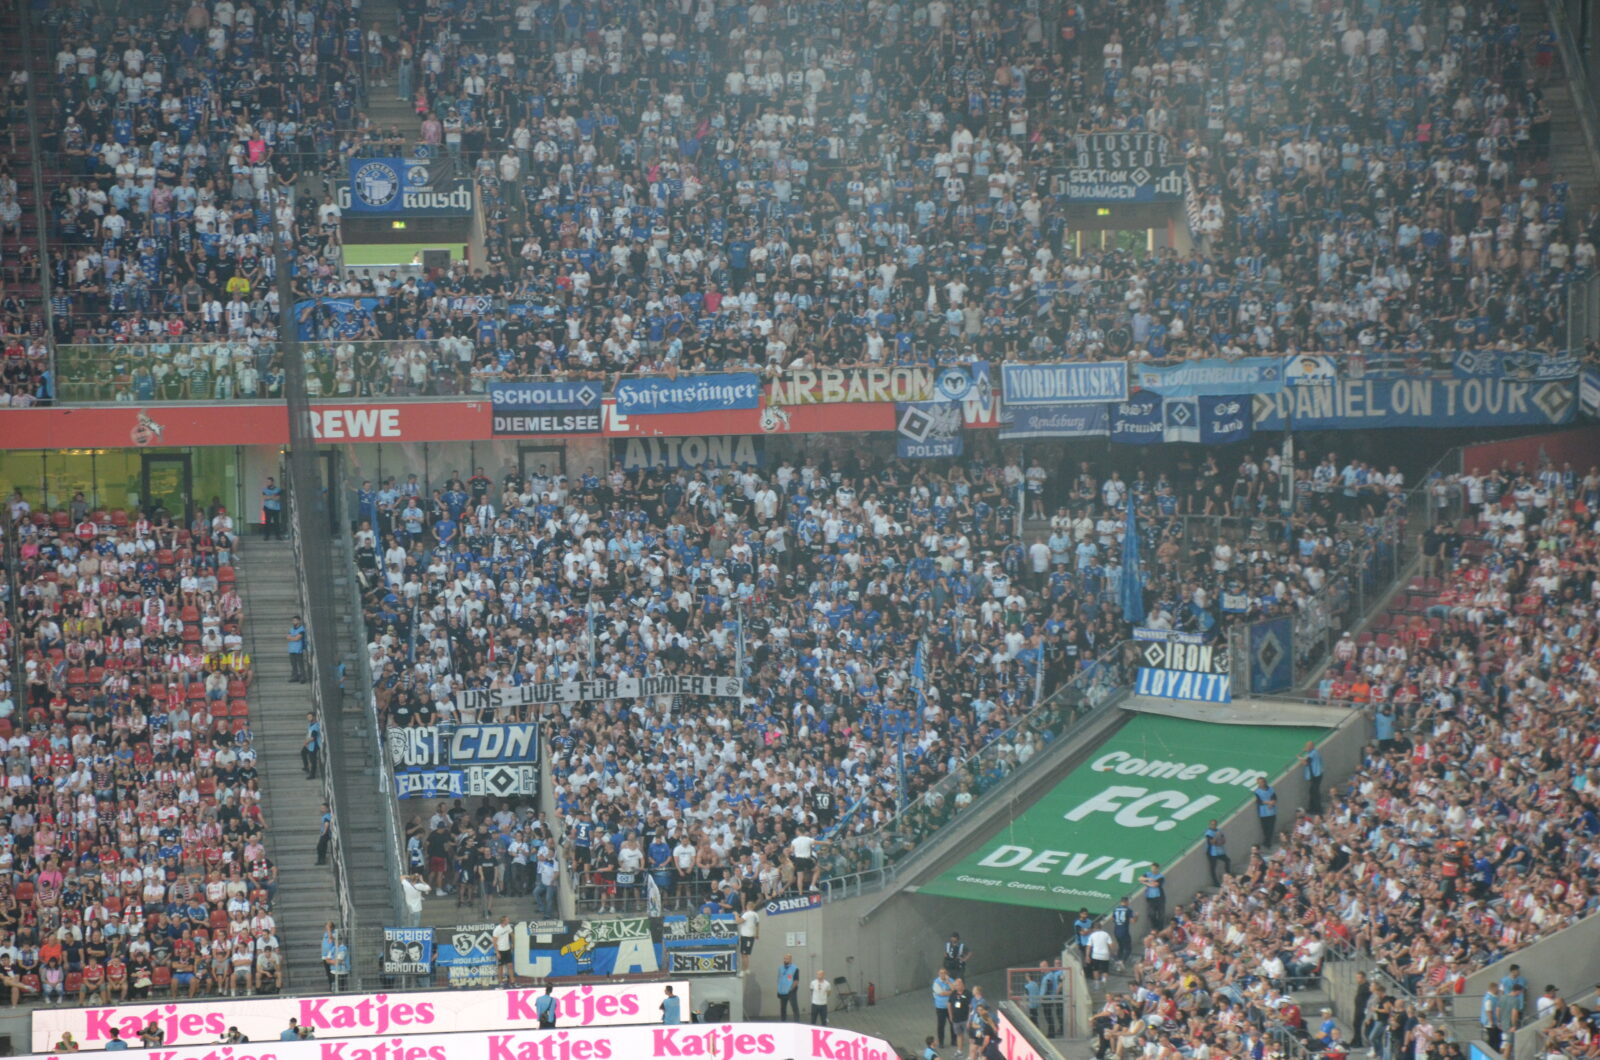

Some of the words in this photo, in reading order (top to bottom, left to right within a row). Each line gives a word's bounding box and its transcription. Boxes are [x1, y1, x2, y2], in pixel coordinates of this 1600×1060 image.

[1076, 134, 1169, 152] KLOSTER
[493, 389, 574, 404] SCHOLLI
[618, 381, 756, 408] Hafensänger
[1009, 366, 1123, 400] NORDHAUSEN
[1276, 379, 1386, 420] DANIEL
[1392, 379, 1432, 416] ON
[1442, 377, 1529, 416] TOUR
[494, 415, 599, 431] DIEMELSEE
[1113, 419, 1164, 434] Freunde
[1211, 419, 1244, 434] Land
[624, 437, 758, 469] ALTONA
[907, 444, 954, 457] POLEN
[1165, 641, 1213, 672] IRON
[464, 689, 504, 709] UNS
[520, 683, 565, 703] UWE
[579, 678, 619, 699] FÜR
[1139, 667, 1230, 702] LOYALTY
[451, 724, 536, 760] CDN
[1091, 751, 1208, 781] Come
[397, 771, 463, 797] FORZA
[1064, 785, 1220, 832] FC!
[579, 826, 586, 837] 5
[977, 844, 1153, 884] DEVK
[779, 897, 809, 911] RNR
[385, 930, 432, 941] BIERIGE
[385, 962, 430, 974] BANDITEN
[85, 1004, 226, 1045] Katjes
[299, 993, 435, 1035] Katjes
[488, 1031, 612, 1060] Katjes
[653, 1025, 775, 1060] Katjes
